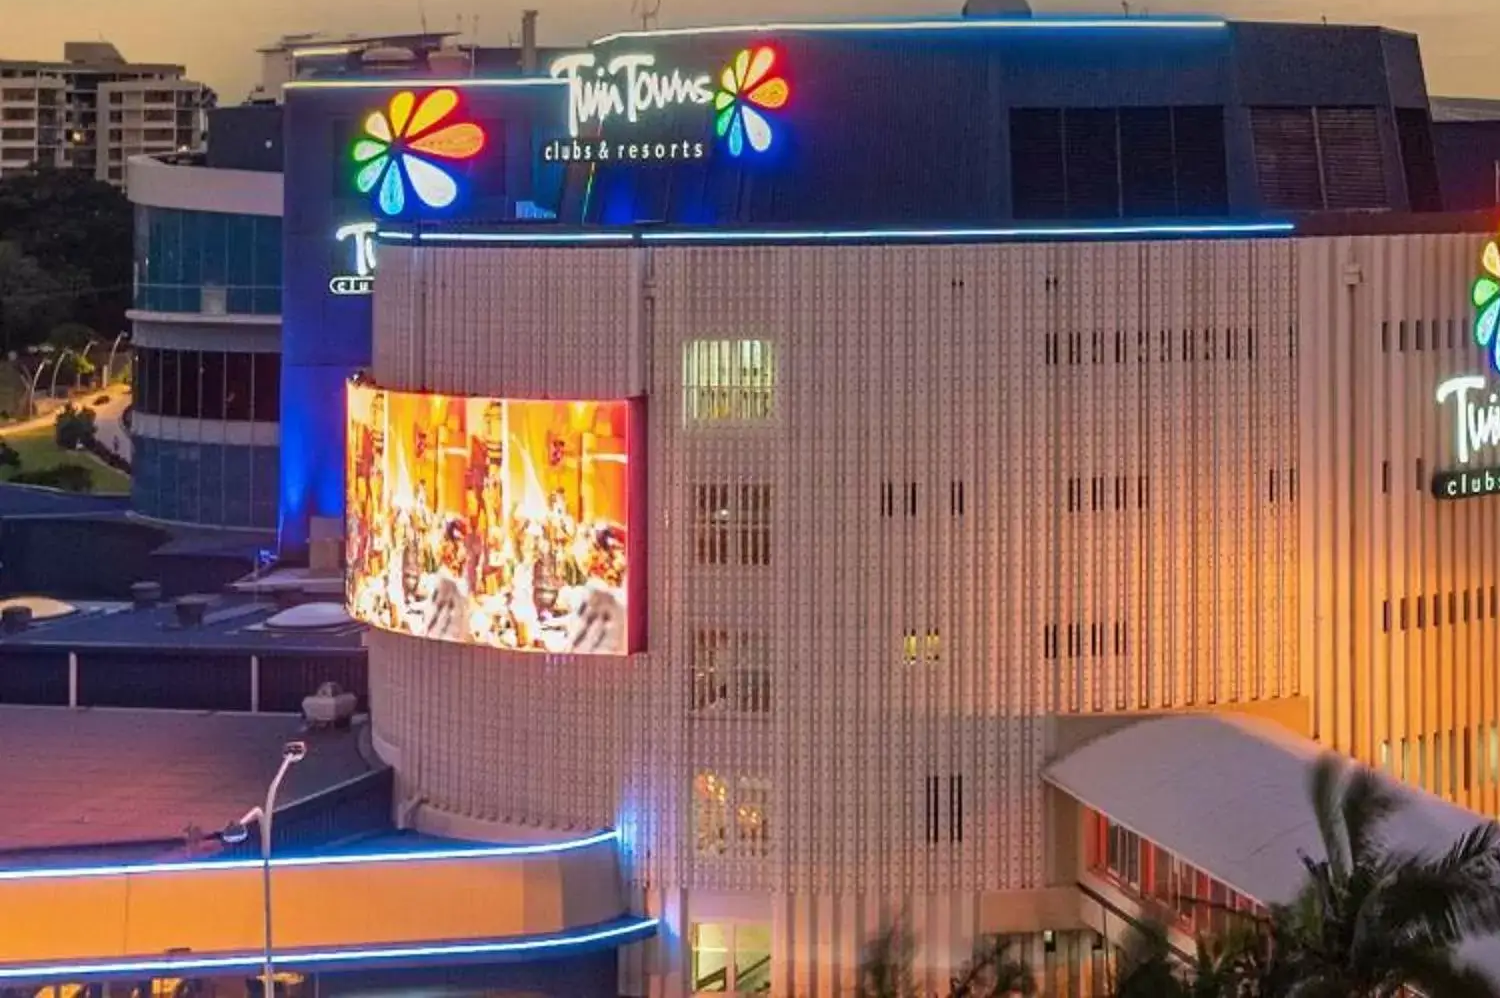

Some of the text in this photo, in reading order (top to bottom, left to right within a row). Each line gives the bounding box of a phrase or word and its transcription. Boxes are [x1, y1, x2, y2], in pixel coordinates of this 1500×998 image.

[550, 54, 714, 137] Twin Towns
[544, 140, 703, 160] clubs & resorts
